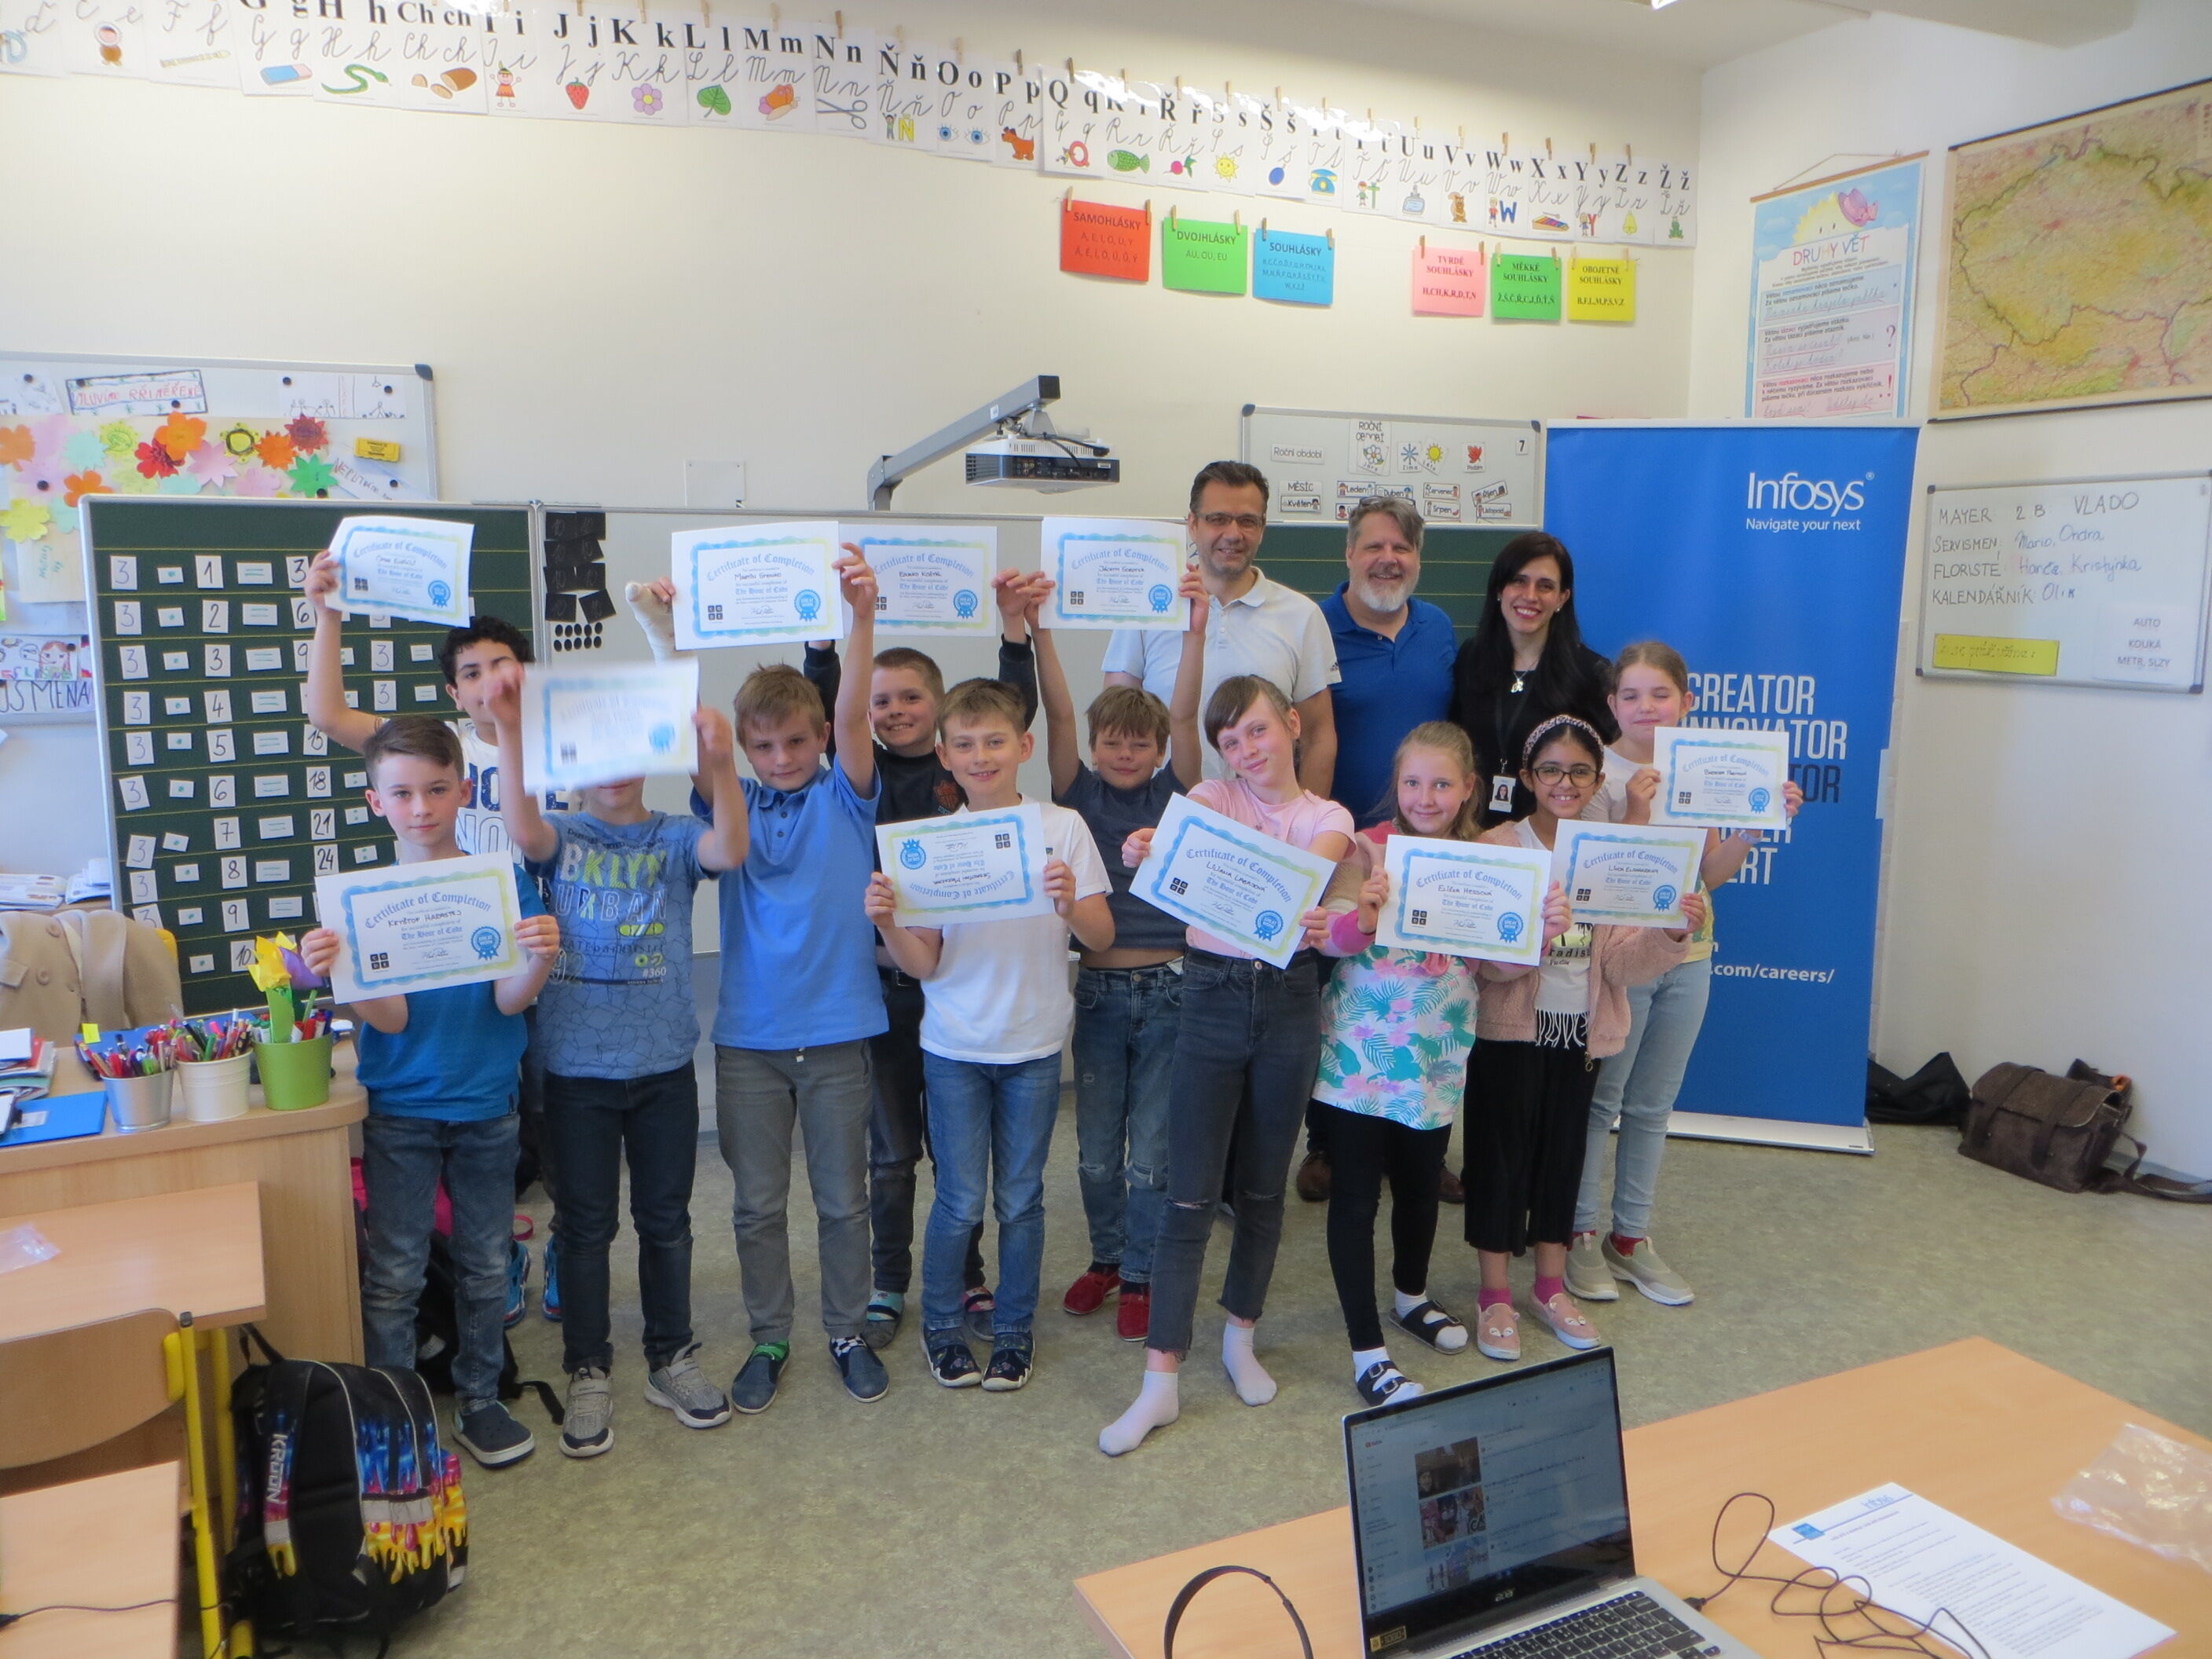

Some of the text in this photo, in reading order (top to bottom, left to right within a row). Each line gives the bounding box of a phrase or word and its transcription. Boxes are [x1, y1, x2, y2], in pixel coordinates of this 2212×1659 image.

[398, 3, 471, 26] Ch ch
[554, 14, 597, 47] J j
[613, 19, 674, 47] K k
[686, 24, 730, 50] L l
[745, 28, 802, 53] M m
[816, 35, 861, 63] N n
[881, 44, 925, 80] Ň ň
[939, 61, 982, 87] O o
[997, 72, 1039, 104] P p
[1049, 80, 1097, 113] Q q
[1160, 91, 1178, 122] Ř
[1260, 102, 1273, 131] Š
[1401, 135, 1415, 157] U
[1445, 145, 1459, 166] V
[1486, 151, 1506, 170] W
[1531, 158, 1547, 179] X
[1575, 161, 1589, 181] Y
[1616, 163, 1628, 183] Z
[1660, 163, 1672, 189] Ž
[1073, 212, 1141, 230] SAMOHLÁSKY
[1177, 230, 1236, 245] DVOJHLÁSKY
[1269, 242, 1321, 257] SOUHLÁSKY
[1842, 233, 1870, 254] VĚT
[1426, 265, 1474, 277] SOUHLÁSKY
[1438, 255, 1464, 265] TVRDÉ
[1503, 273, 1548, 284] SOUHLÁSKY
[1273, 446, 1322, 459] Roční období
[1519, 440, 1525, 452] 7
[1747, 472, 1865, 518] Infosys
[1939, 507, 1992, 525] MAYER
[2034, 505, 2046, 518] B
[2075, 493, 2139, 515] VLADO
[1746, 518, 1861, 533] Navigate your next
[2060, 524, 2105, 542] Ondra
[115, 559, 306, 584] 3 1 3
[706, 553, 815, 581] Certificate of Completion
[874, 553, 974, 578] Certificate of Completion
[1071, 548, 1170, 573] Certificate of Completion
[121, 602, 309, 628] 3 2 6
[2133, 617, 2161, 628] AUTO
[126, 643, 308, 673] 3 3 9
[1687, 672, 1816, 715] CREATOR
[131, 694, 223, 720] 3 4
[134, 727, 324, 760] 3 5 15
[126, 771, 326, 803] 3 6 18
[132, 813, 331, 862] 3 7 21
[137, 848, 333, 897] 3 8 24
[1584, 850, 1679, 874] Certificate of Completion
[910, 870, 1016, 900] Certificate of Completion
[1186, 848, 1292, 903] Certificate of Completion
[1416, 870, 1523, 900] Certificate of Completion
[228, 904, 237, 924] 9
[364, 892, 491, 928] Certificate of Completion
[438, 928, 445, 937] of
[236, 945, 251, 966] 10
[643, 966, 667, 978] #360
